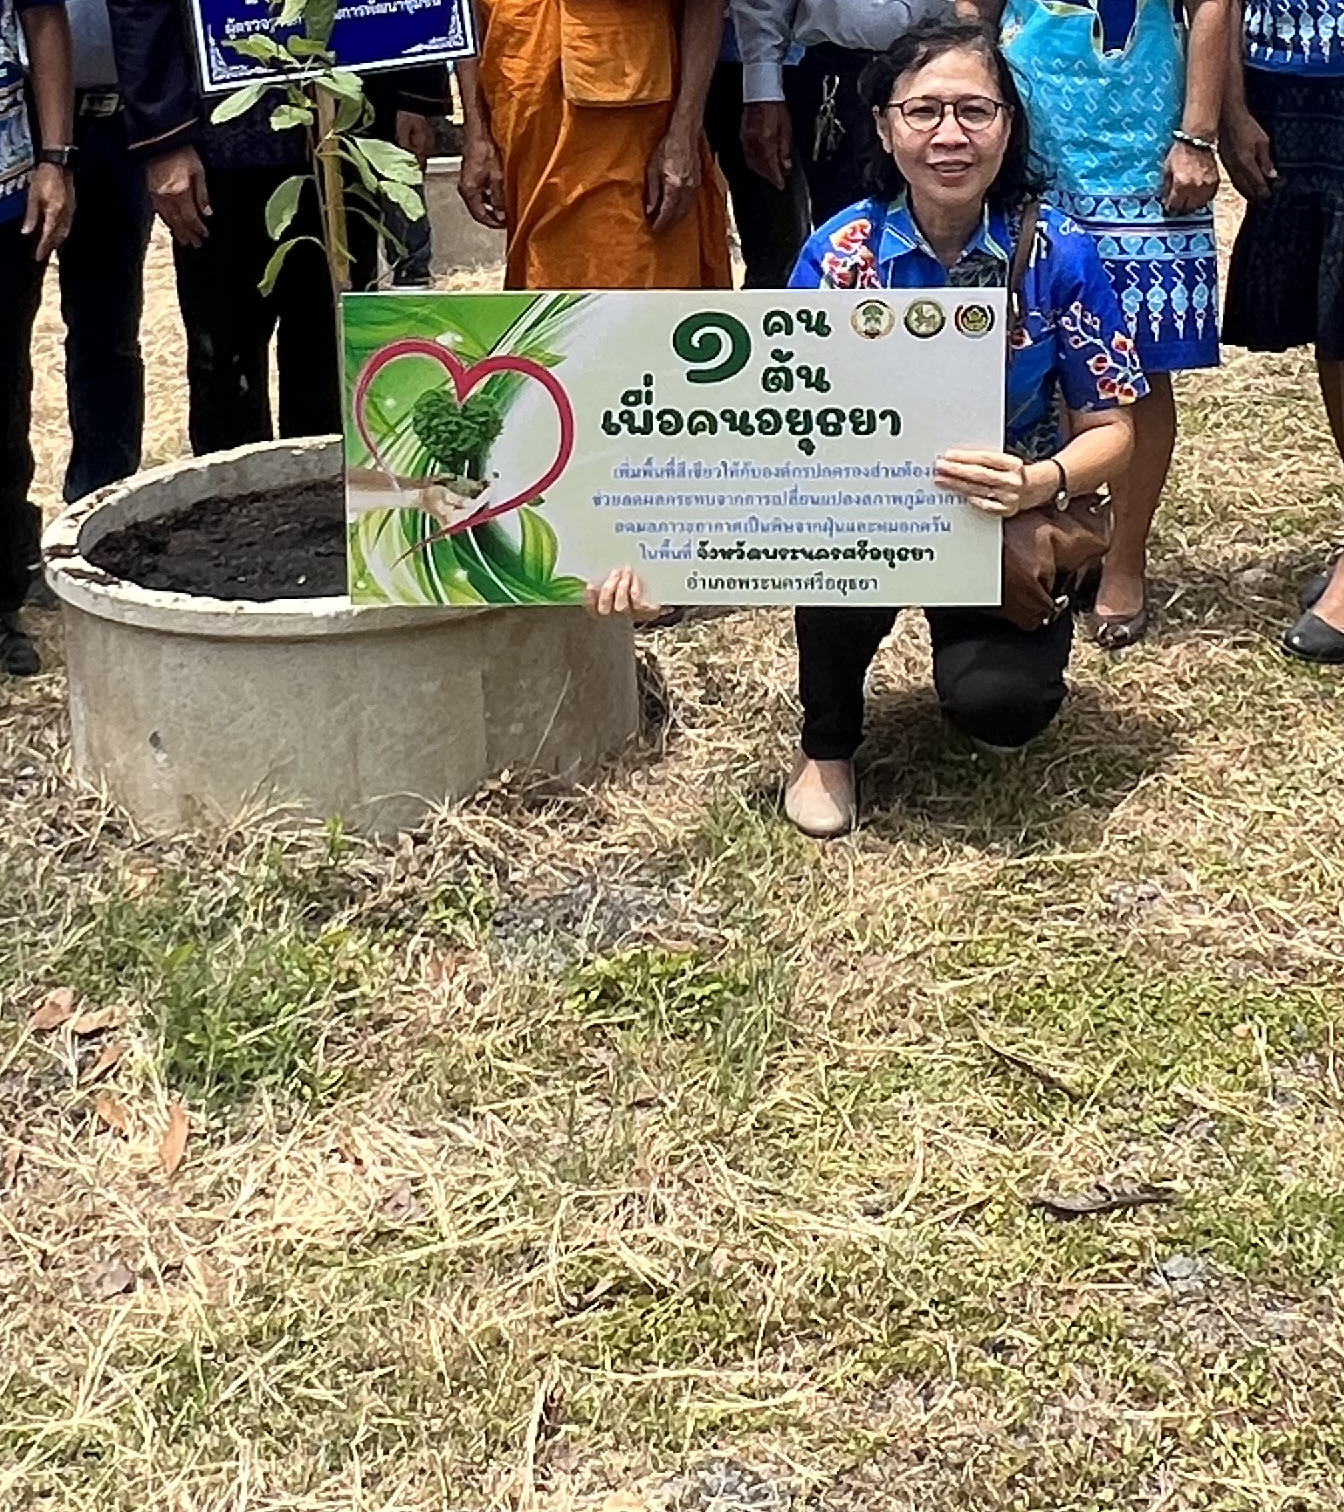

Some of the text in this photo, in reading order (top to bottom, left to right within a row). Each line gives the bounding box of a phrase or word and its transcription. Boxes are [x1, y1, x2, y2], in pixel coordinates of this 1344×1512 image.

[762, 309, 831, 337] คน
[761, 349, 832, 393] ต้น
[601, 373, 902, 456] เพื่อคนอยุธยา
